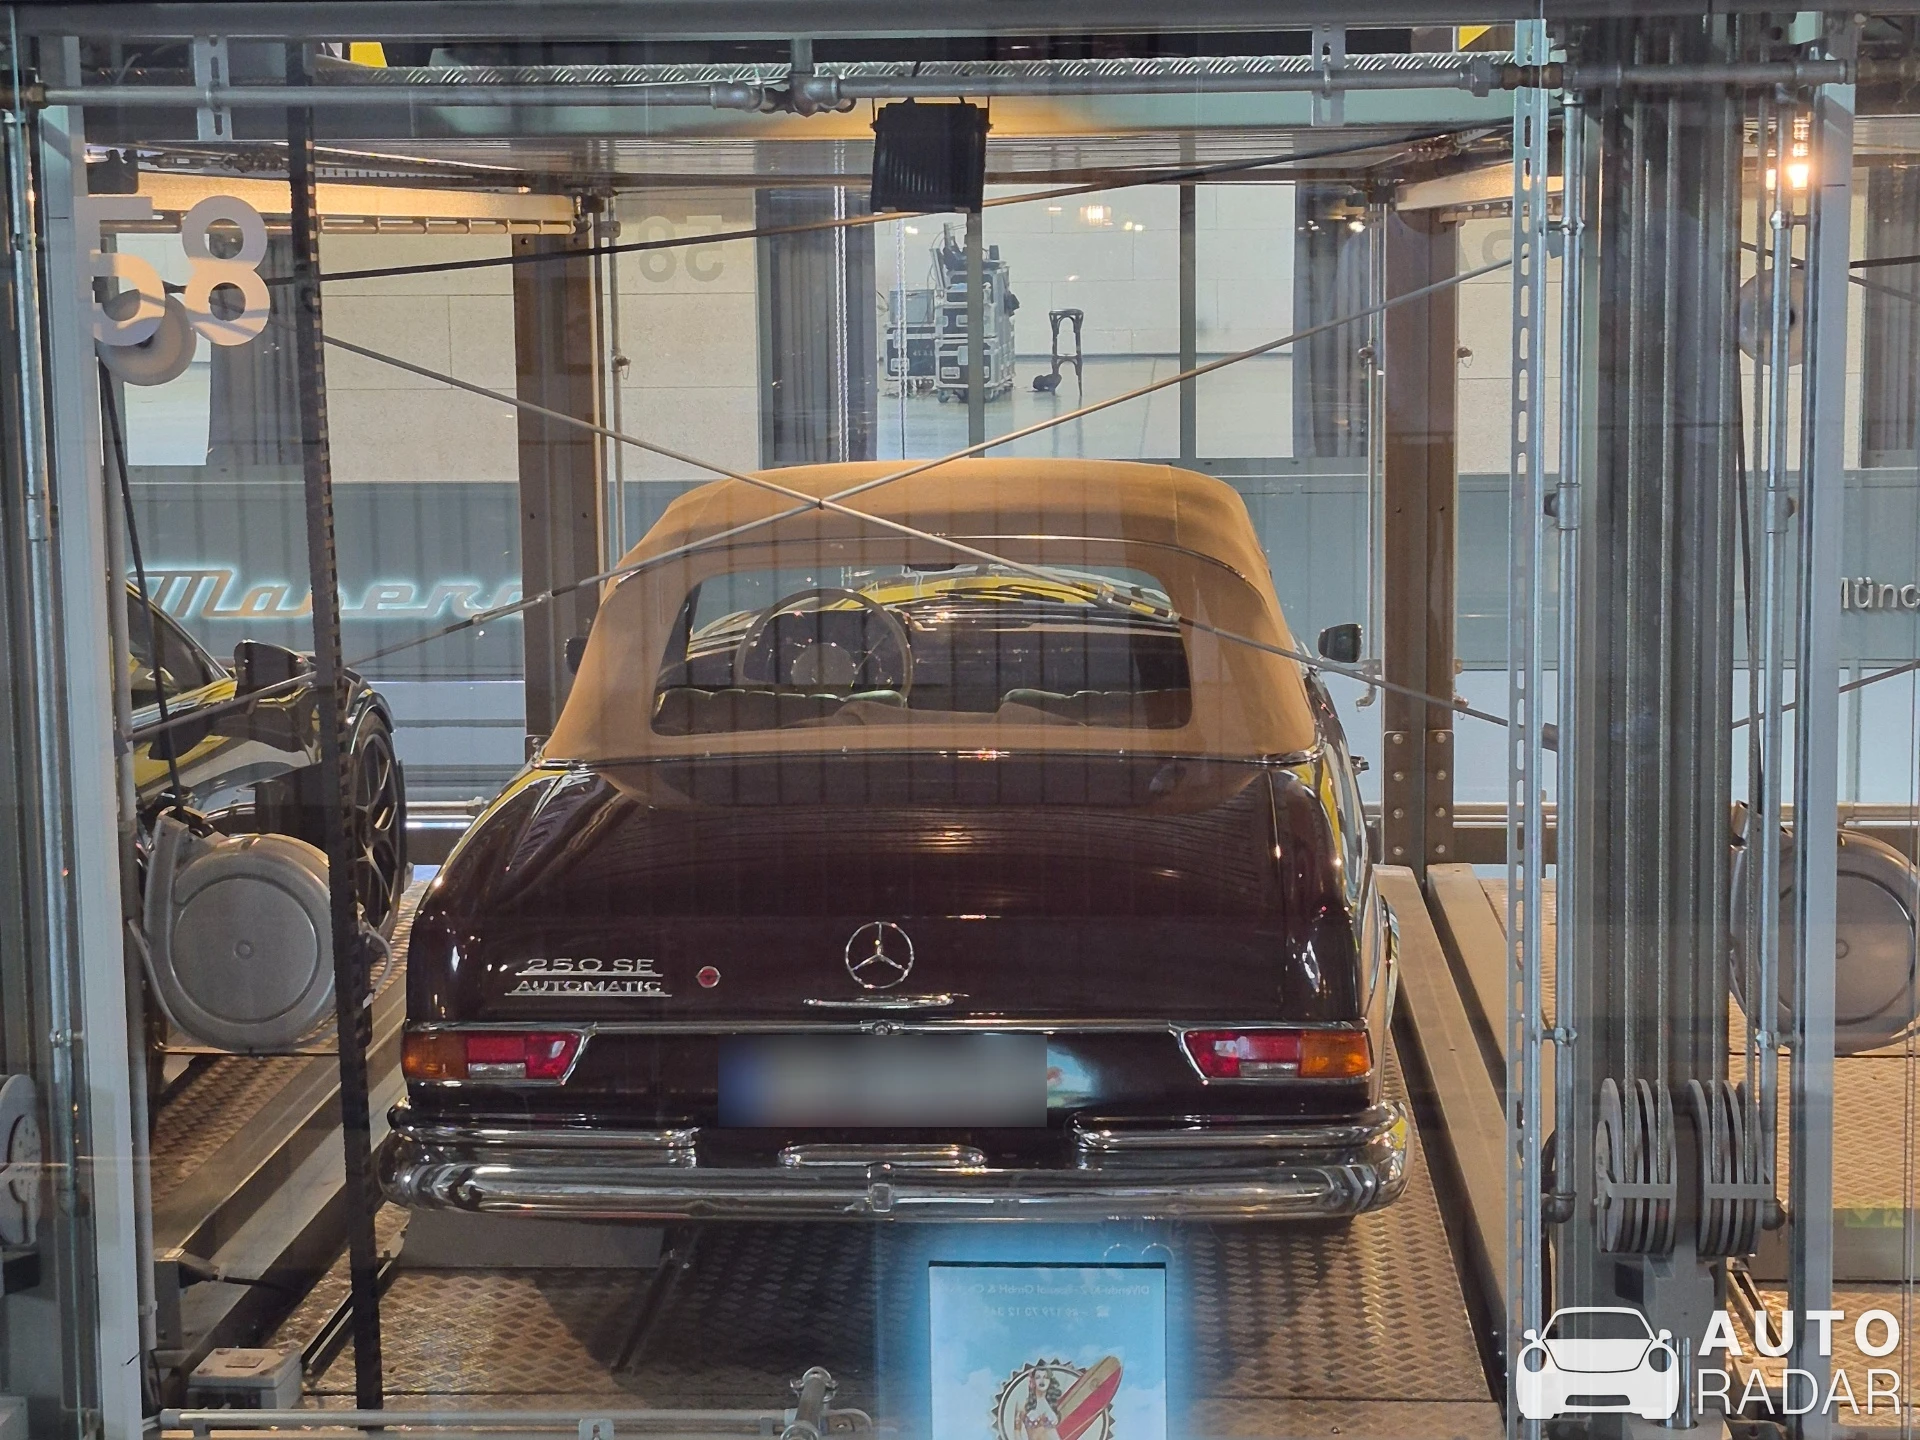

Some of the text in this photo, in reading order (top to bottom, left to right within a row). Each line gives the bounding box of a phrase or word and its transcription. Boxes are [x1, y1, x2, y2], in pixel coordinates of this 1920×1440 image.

[73, 195, 271, 347] 58
[127, 569, 522, 618] Maer
[527, 958, 655, 974] 250 SE
[514, 980, 662, 993] AUTOMATIC
